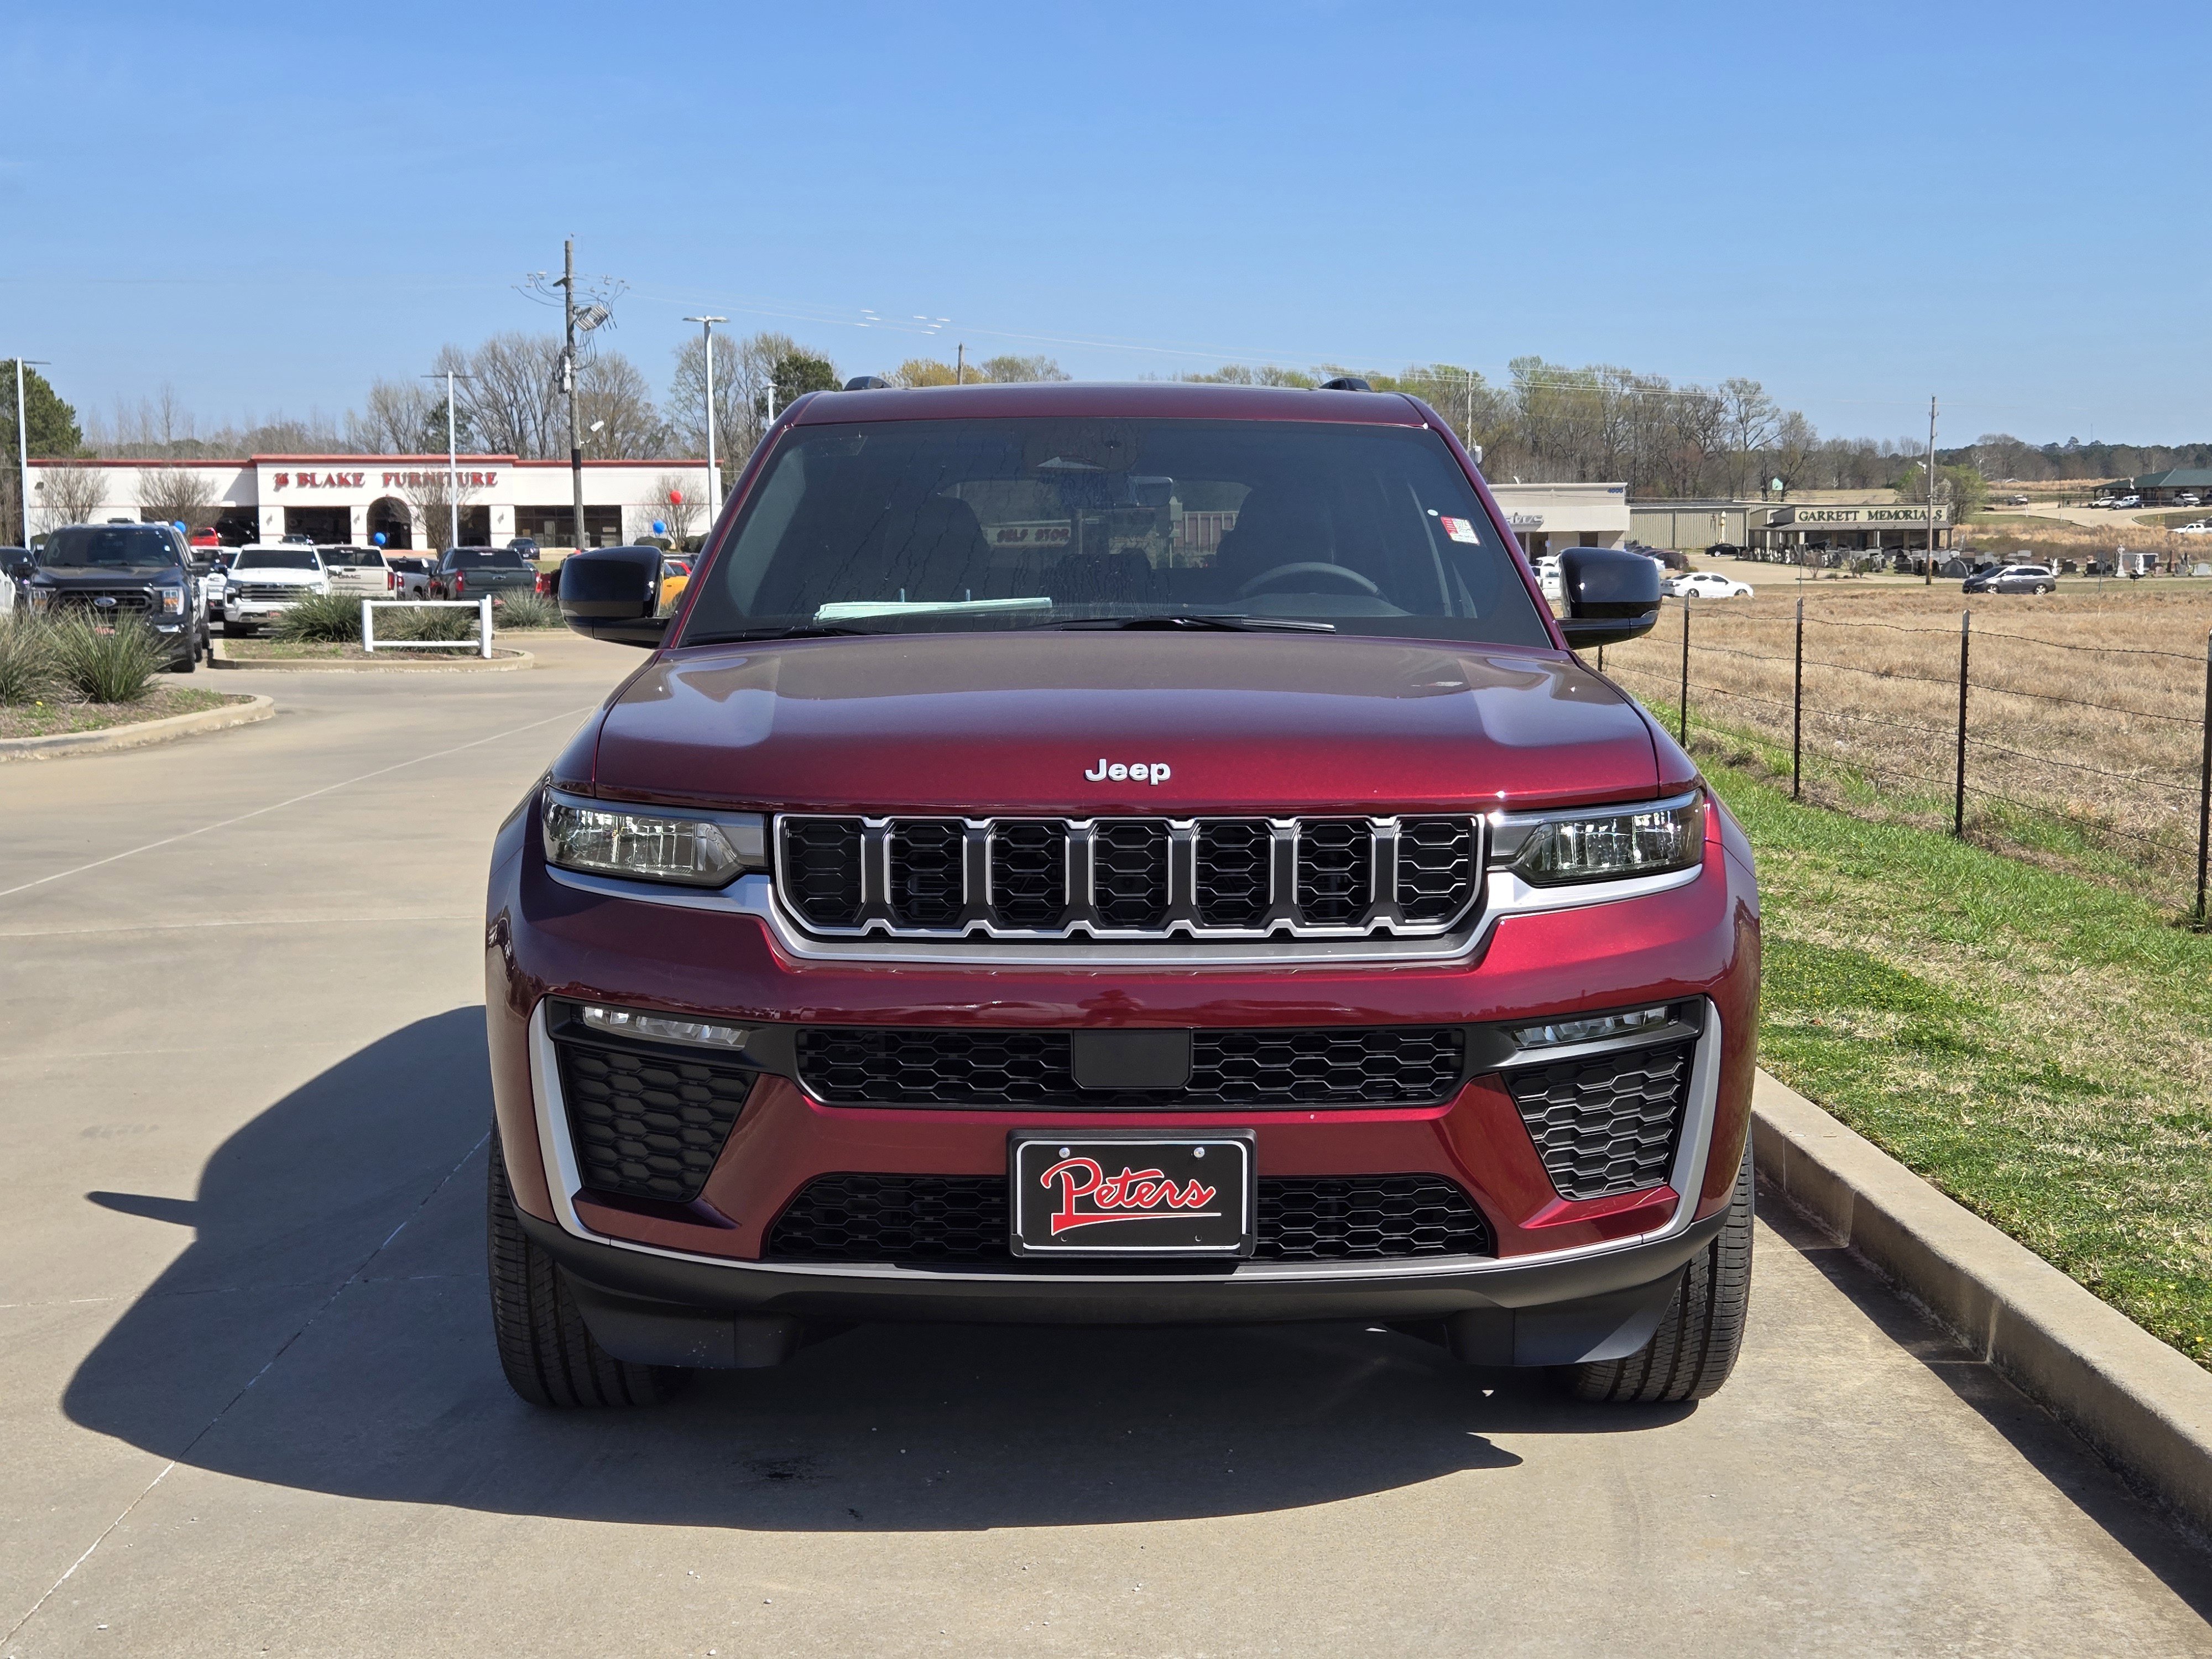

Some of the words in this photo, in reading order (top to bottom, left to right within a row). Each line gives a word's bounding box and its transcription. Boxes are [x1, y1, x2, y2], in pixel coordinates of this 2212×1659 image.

[295, 472, 366, 488] BLAKE
[1799, 510, 1859, 522] GARRETT
[1867, 509, 1942, 521] MEMORIAS
[1085, 759, 1171, 785] Jeep
[1040, 1157, 1217, 1216] Peters
